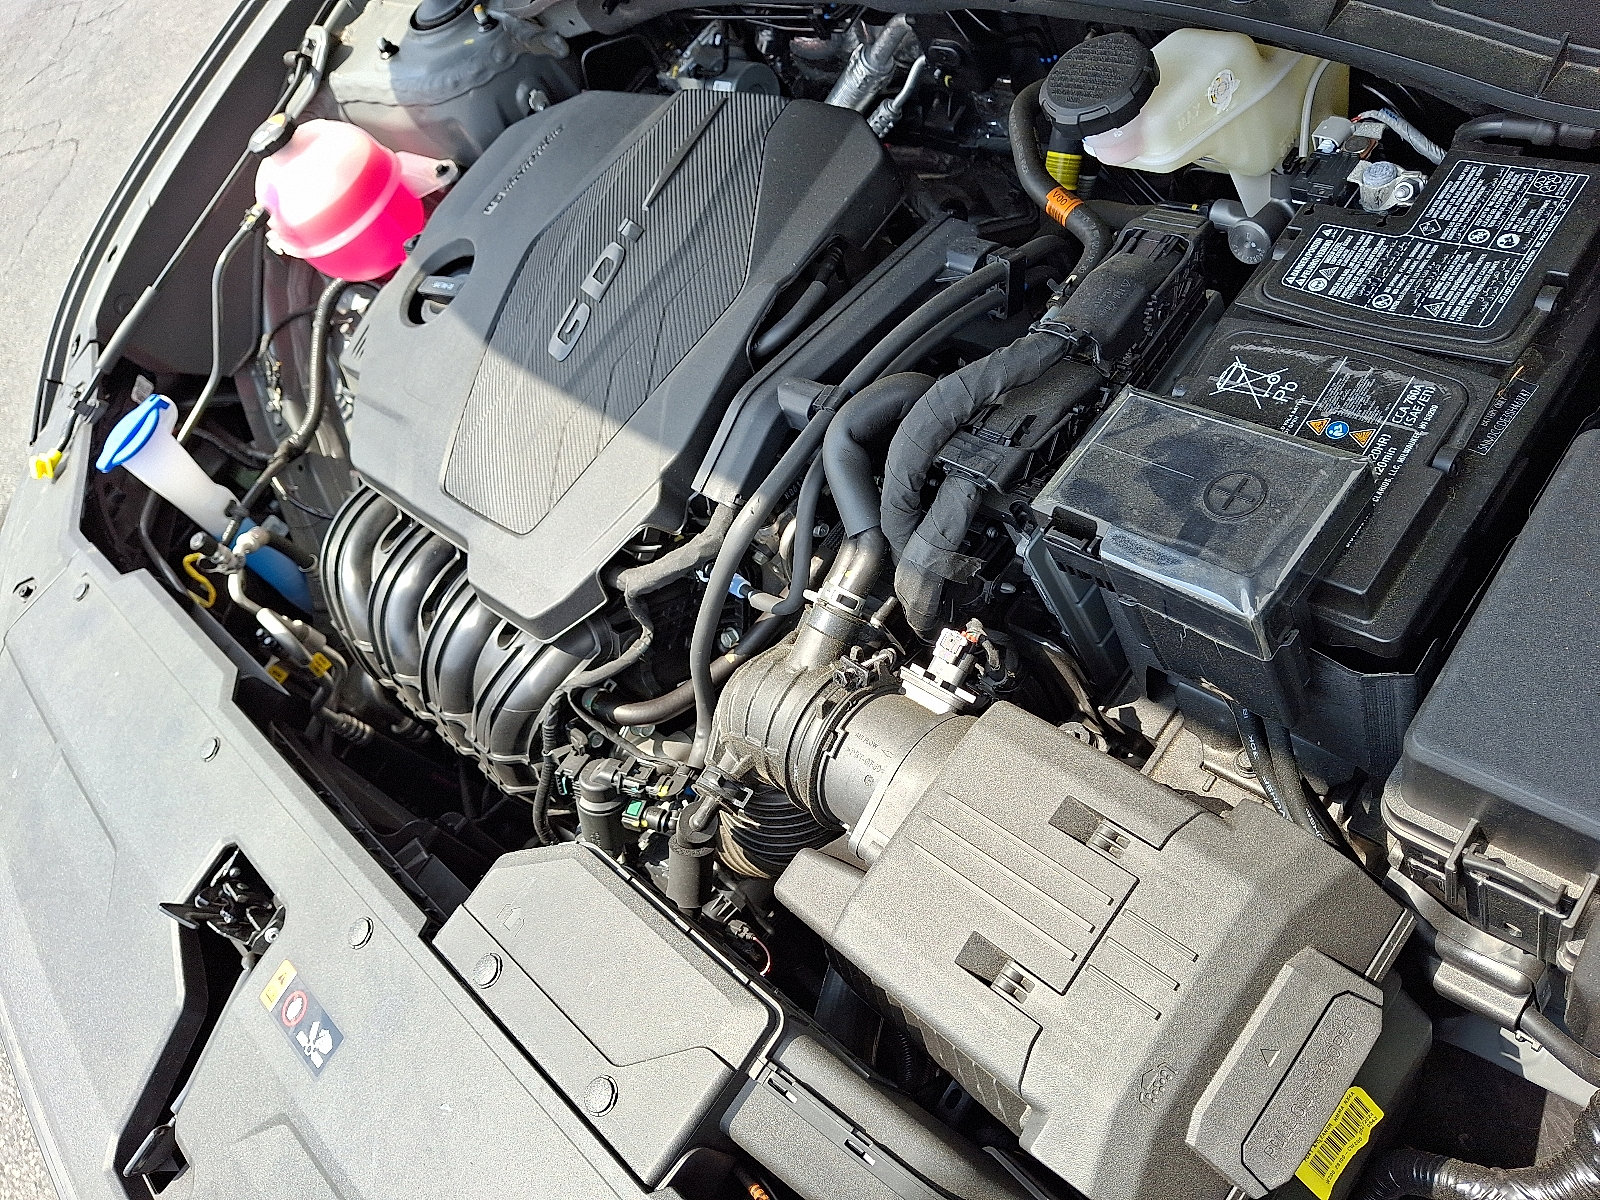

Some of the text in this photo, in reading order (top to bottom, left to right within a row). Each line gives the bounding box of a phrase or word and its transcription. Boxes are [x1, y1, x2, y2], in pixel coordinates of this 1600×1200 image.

[1272, 382, 1297, 402] Pb
[1391, 384, 1424, 423] CCA 760A
[1371, 477, 1394, 502] CLARIOS,
[1388, 463, 1401, 476] LLC,
